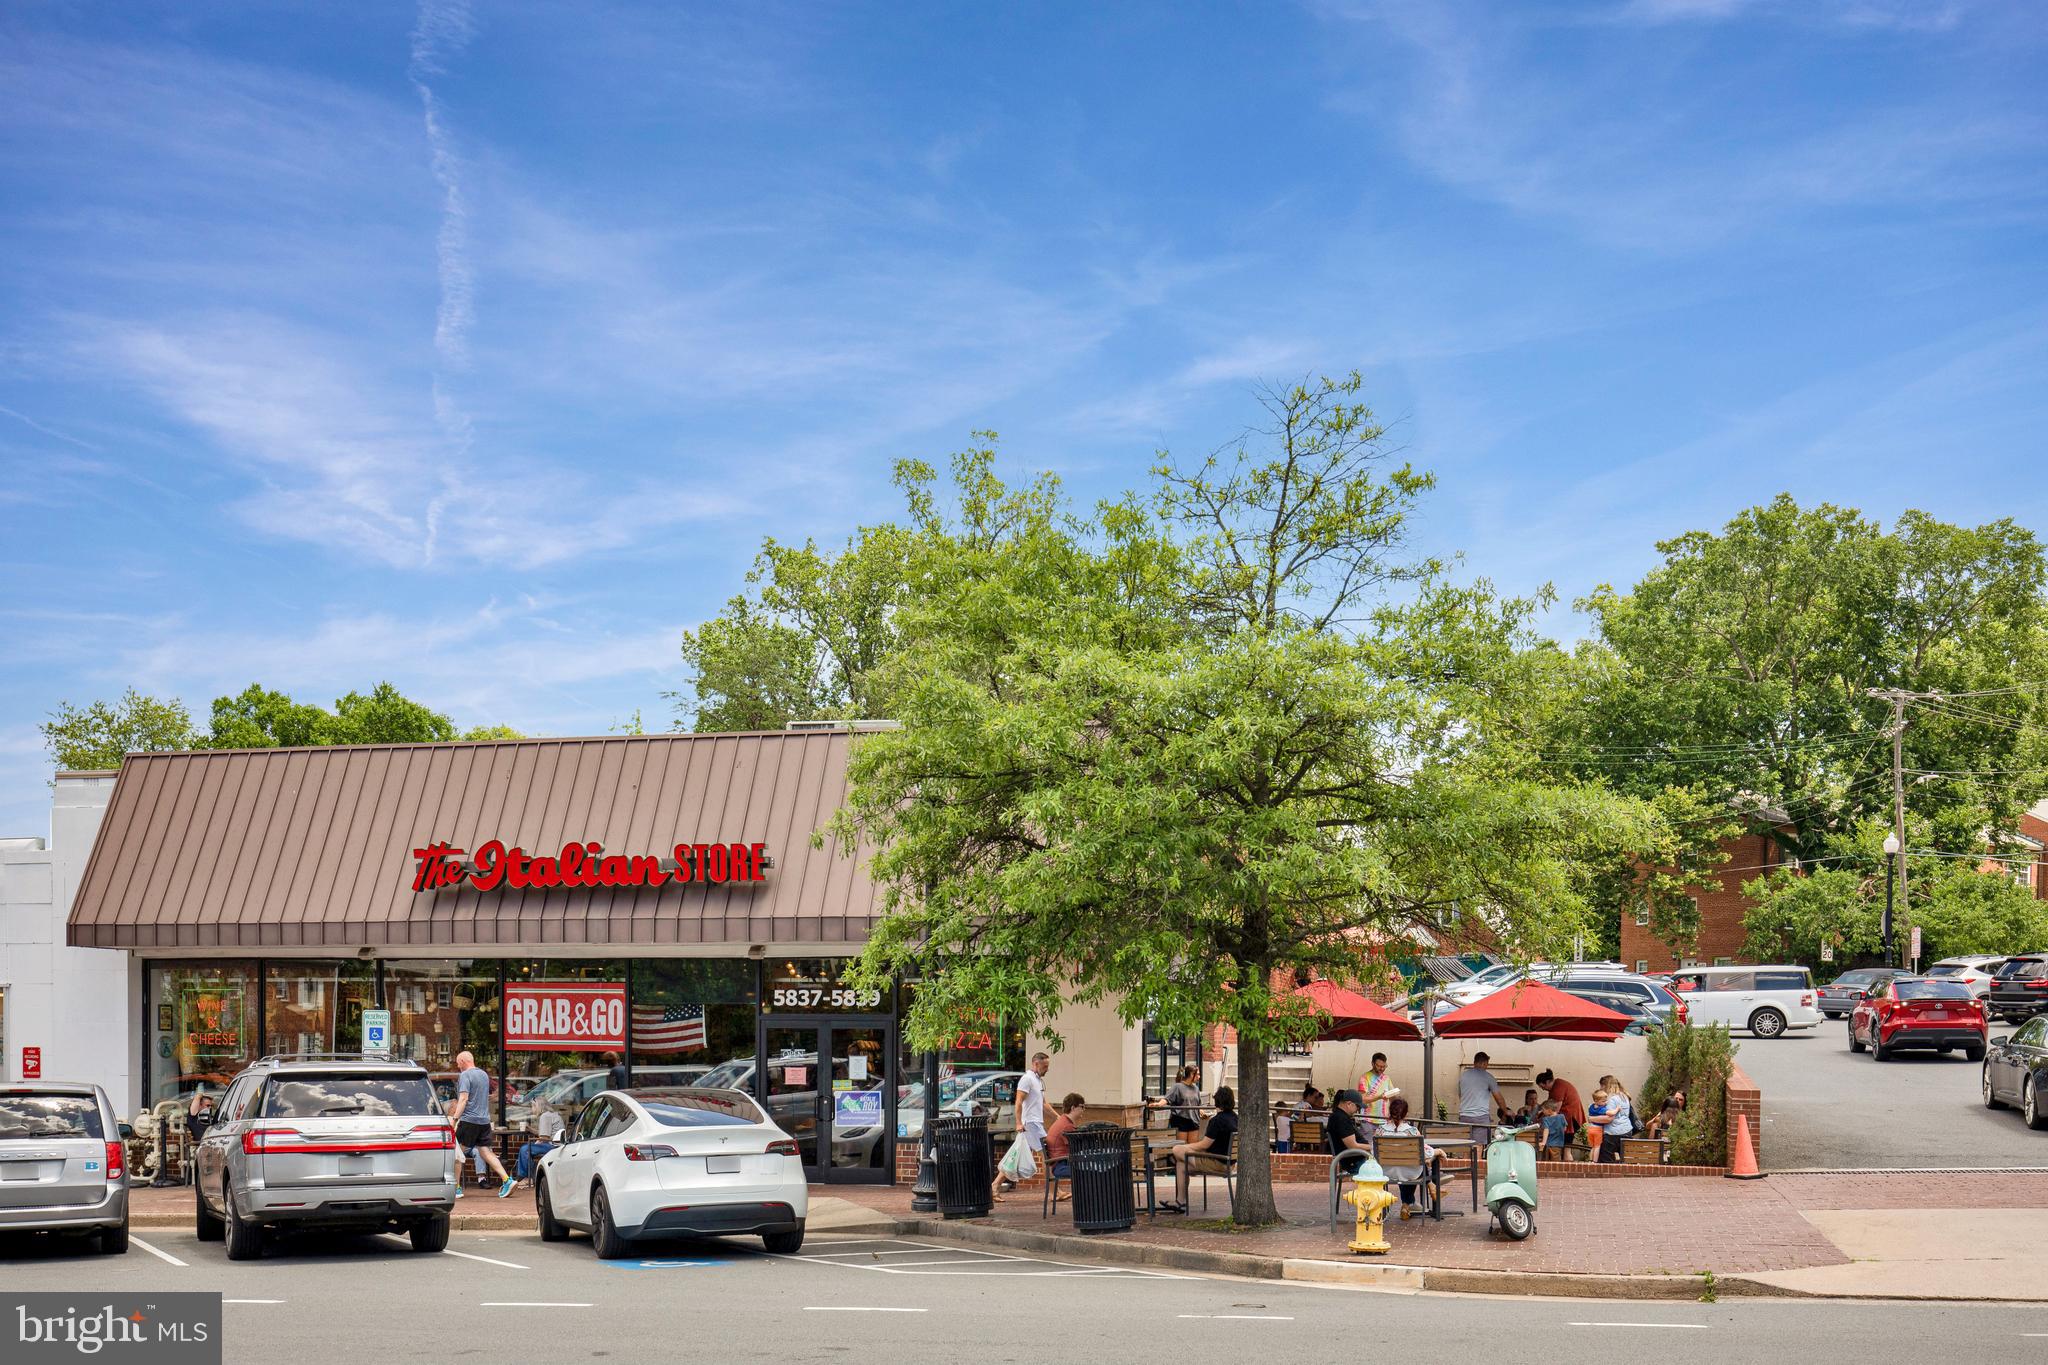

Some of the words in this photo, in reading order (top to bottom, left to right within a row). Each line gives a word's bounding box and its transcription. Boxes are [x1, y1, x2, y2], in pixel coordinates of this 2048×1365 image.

[412, 841, 465, 892] The
[469, 839, 670, 891] Italian
[674, 843, 768, 884] STORE
[1823, 950, 1833, 959] 20
[773, 989, 881, 1008] 5837-5839
[196, 1000, 227, 1012] WINE
[207, 1016, 218, 1029] &
[189, 1032, 237, 1046] CHEESE
[862, 1101, 878, 1111] ROY
